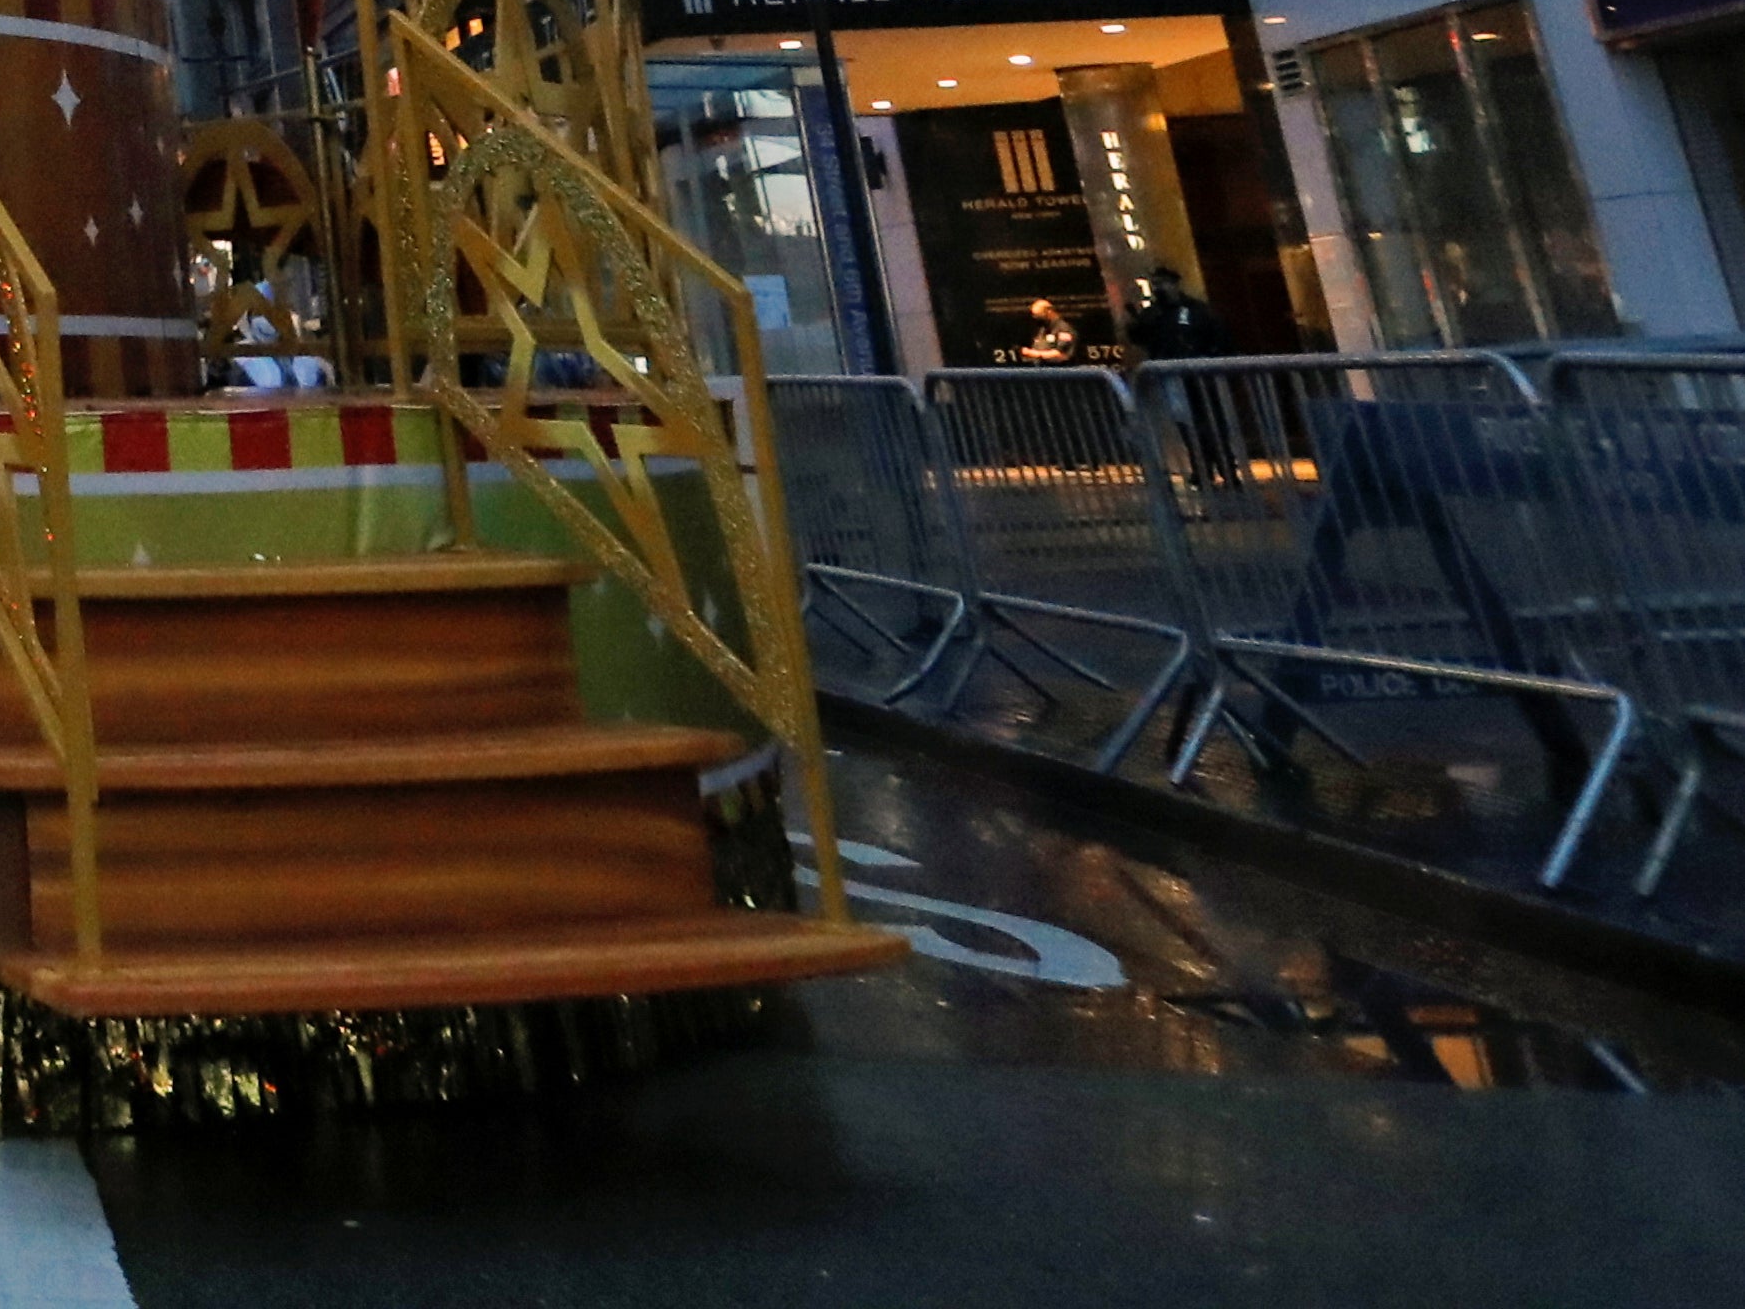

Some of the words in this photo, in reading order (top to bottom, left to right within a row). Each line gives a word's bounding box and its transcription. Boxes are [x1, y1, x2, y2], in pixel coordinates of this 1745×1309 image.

[961, 195, 1029, 212] HERALD
[1035, 193, 1087, 208] TOWE
[1099, 131, 1147, 252] HERALD
